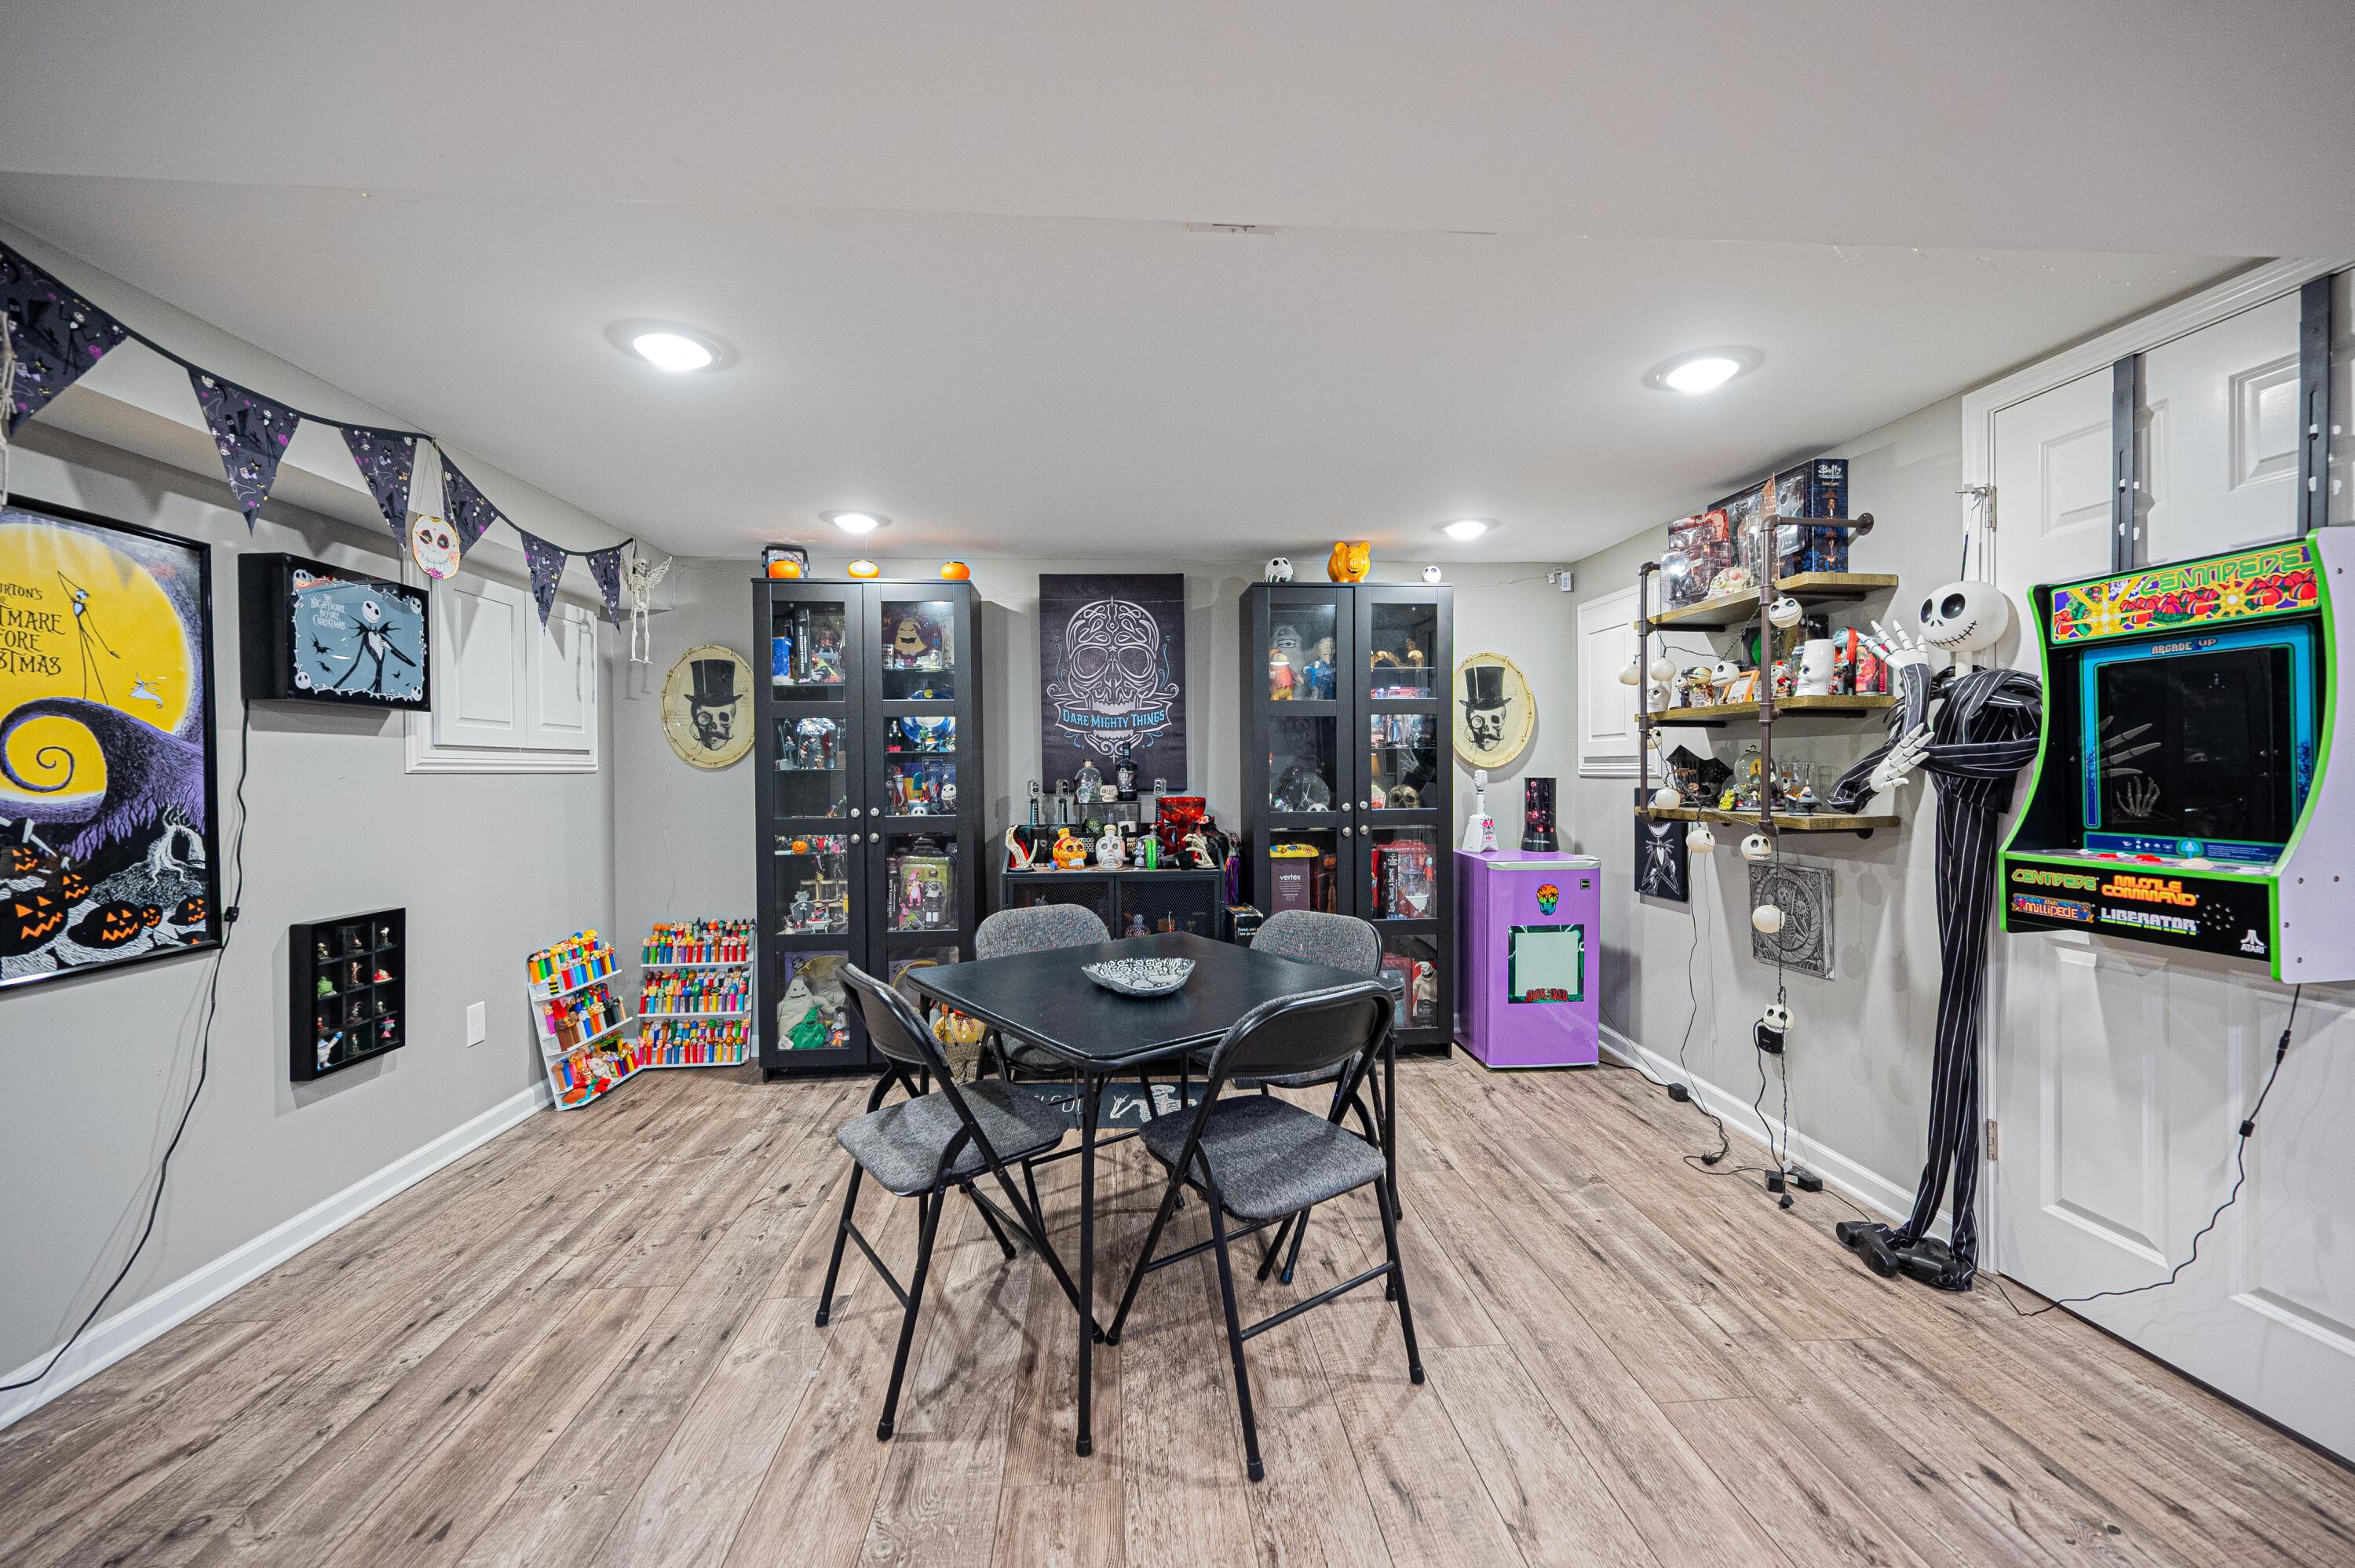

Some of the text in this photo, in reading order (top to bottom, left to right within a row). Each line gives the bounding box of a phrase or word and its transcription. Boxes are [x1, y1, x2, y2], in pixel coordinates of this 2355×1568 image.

[1818, 464, 1842, 475] Buffy
[2140, 549, 2314, 595] CENTIPEDE
[0, 583, 42, 600] RTON'S
[1062, 709, 1165, 728] DARE MIGHTY THINGS
[2011, 869, 2097, 892] CENTIPEDE
[2113, 875, 2182, 893] MISSILE
[2101, 884, 2197, 906] COMMAND
[2101, 907, 2197, 932] LIBERATOR
[2240, 943, 2266, 954] ATARI
